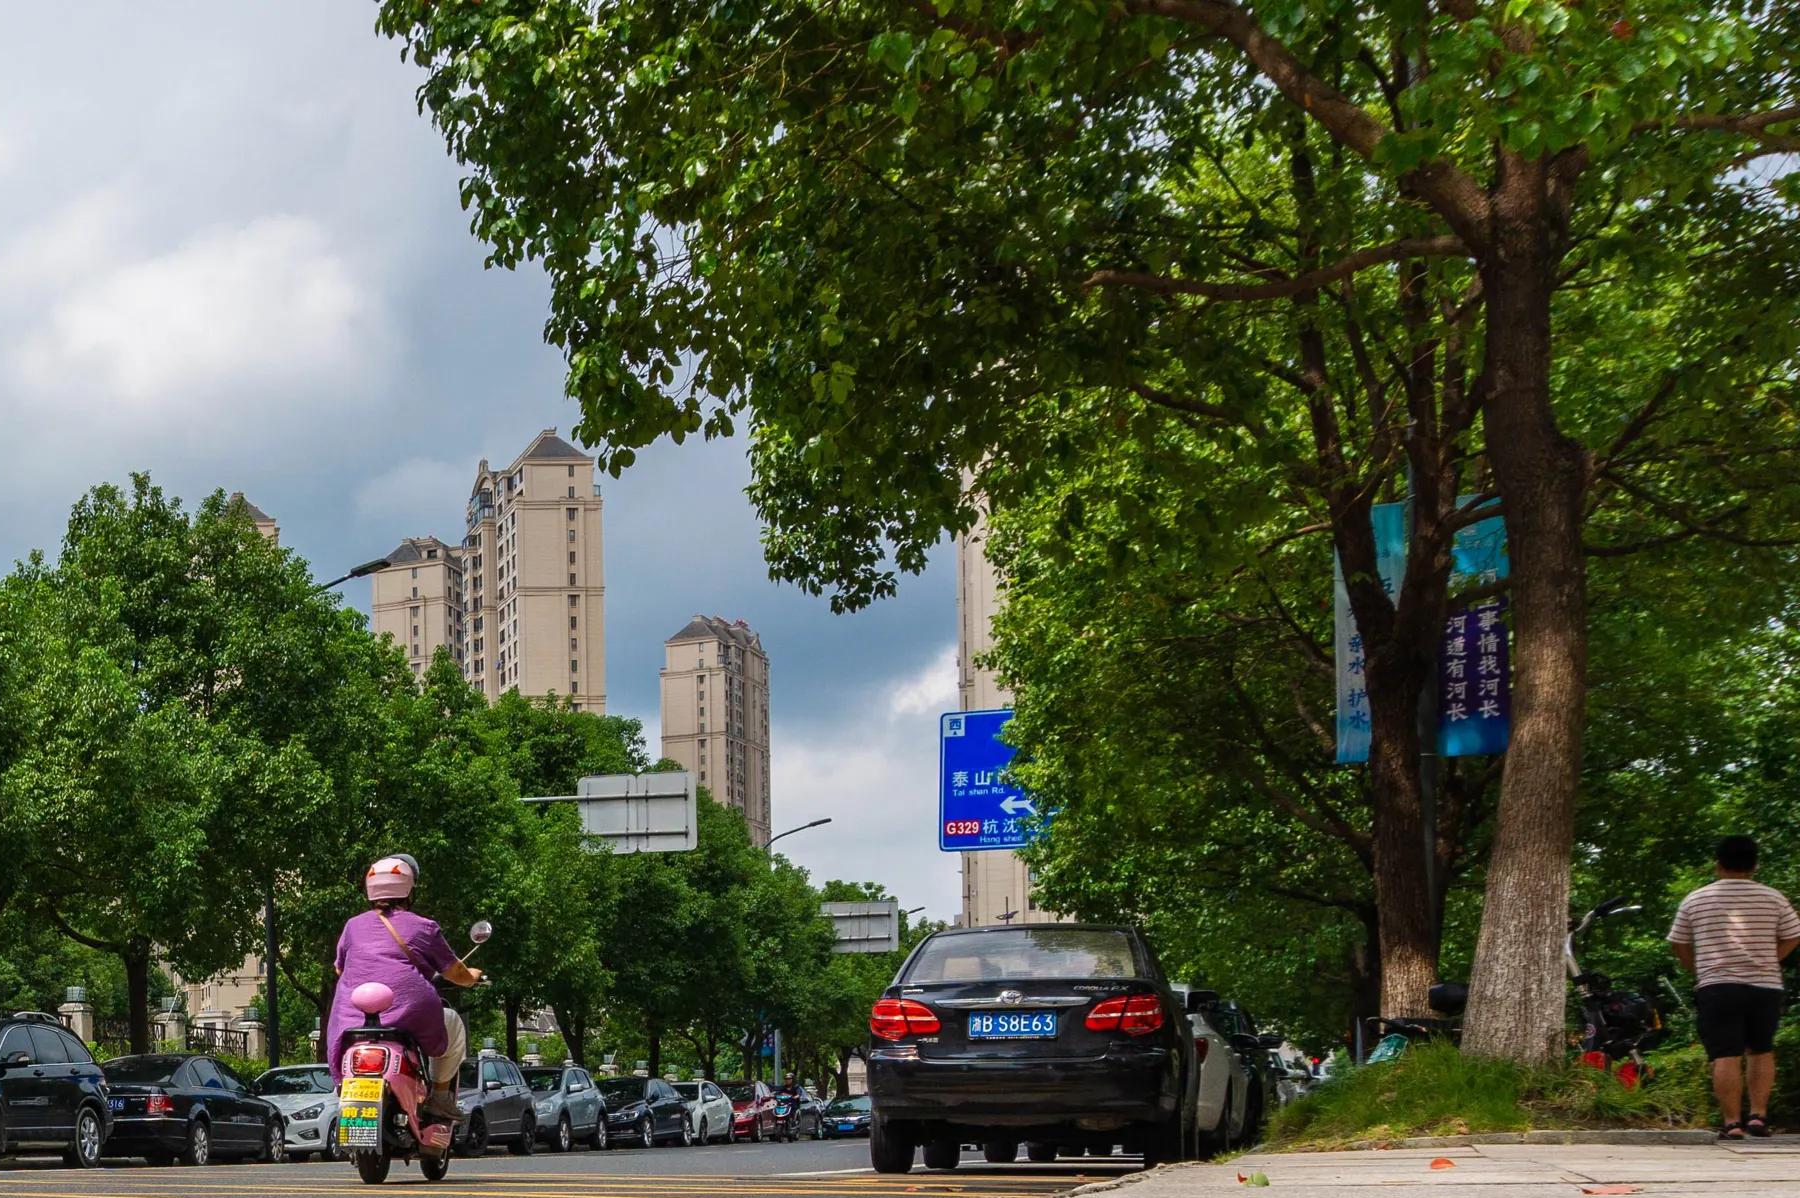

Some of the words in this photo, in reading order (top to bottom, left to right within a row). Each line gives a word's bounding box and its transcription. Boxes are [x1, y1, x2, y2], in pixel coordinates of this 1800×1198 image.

[1446, 571, 1469, 722] 河道有河长
[949, 718, 961, 731] 西
[952, 768, 1014, 789] 泰山
[953, 789, 965, 797] Tai
[969, 787, 988, 795] shan
[946, 821, 979, 834] G329
[980, 835, 1000, 844] Hang
